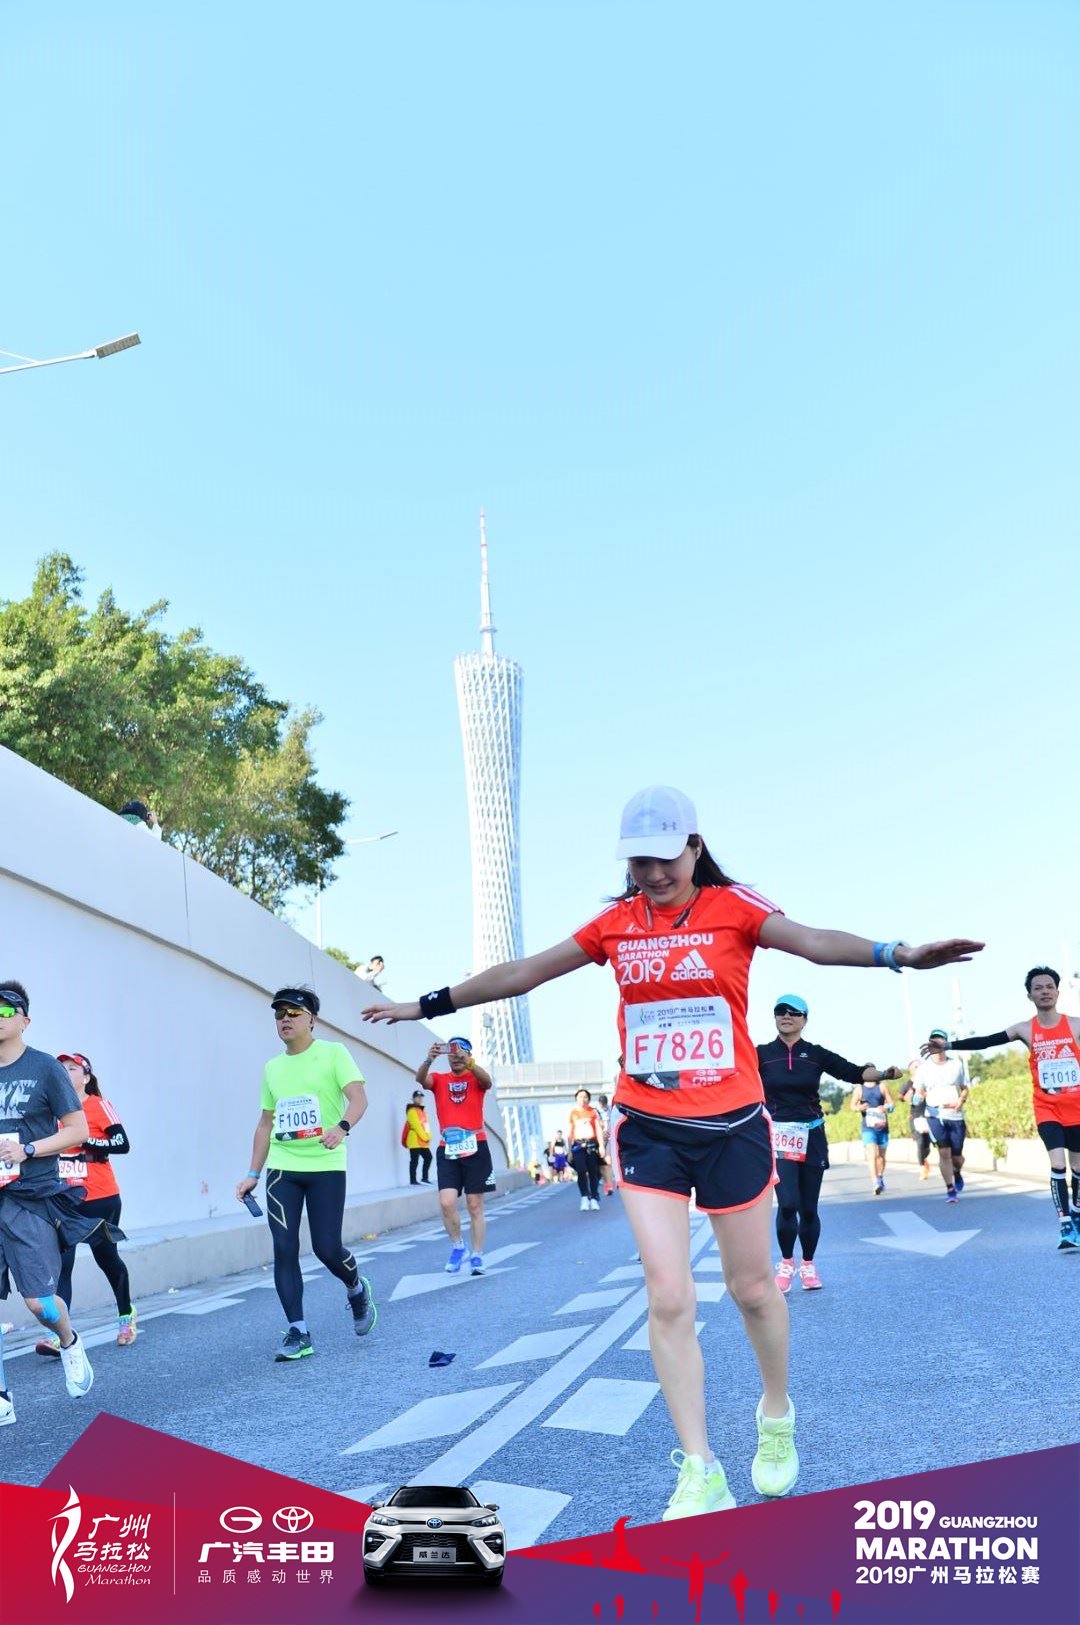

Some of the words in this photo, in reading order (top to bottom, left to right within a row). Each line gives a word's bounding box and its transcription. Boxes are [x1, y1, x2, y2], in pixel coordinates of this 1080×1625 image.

[617, 933, 714, 953] GUANGZHOU
[617, 949, 670, 962] MARATHON
[617, 957, 666, 986] 2019
[670, 968, 715, 981] adidas
[634, 1028, 724, 1065] F7826
[1042, 1069, 1078, 1085] F1018
[279, 1109, 317, 1129] F1005
